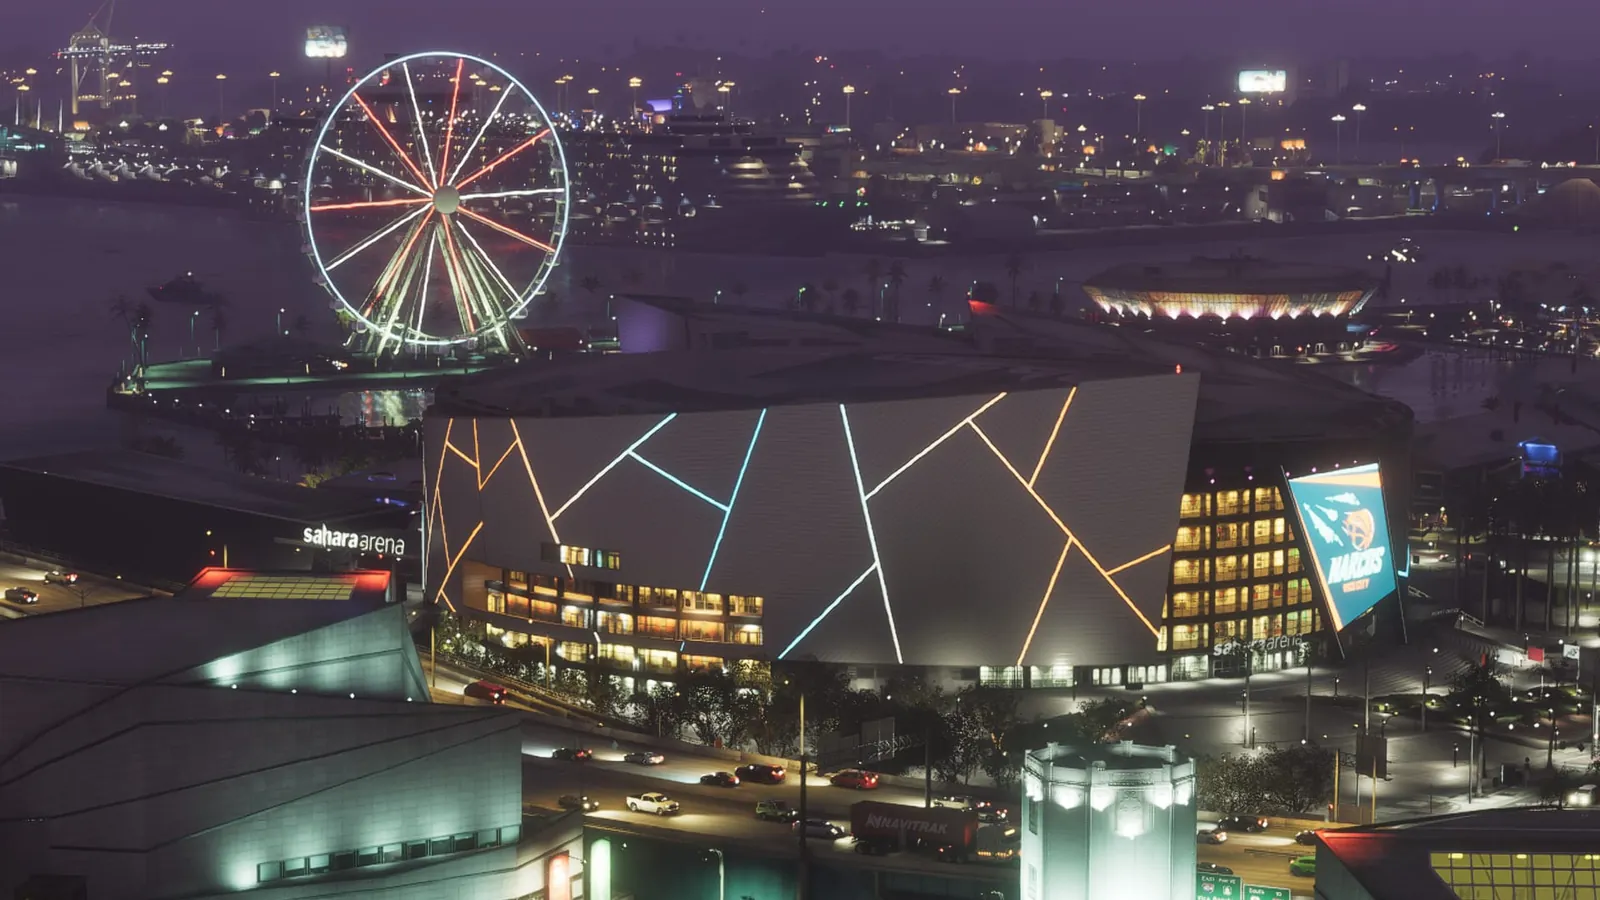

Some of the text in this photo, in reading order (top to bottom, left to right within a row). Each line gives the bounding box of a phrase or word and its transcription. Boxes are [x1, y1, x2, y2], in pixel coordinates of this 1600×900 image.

[303, 522, 405, 555] sahara arena
[881, 817, 949, 834] NAVITRAK
